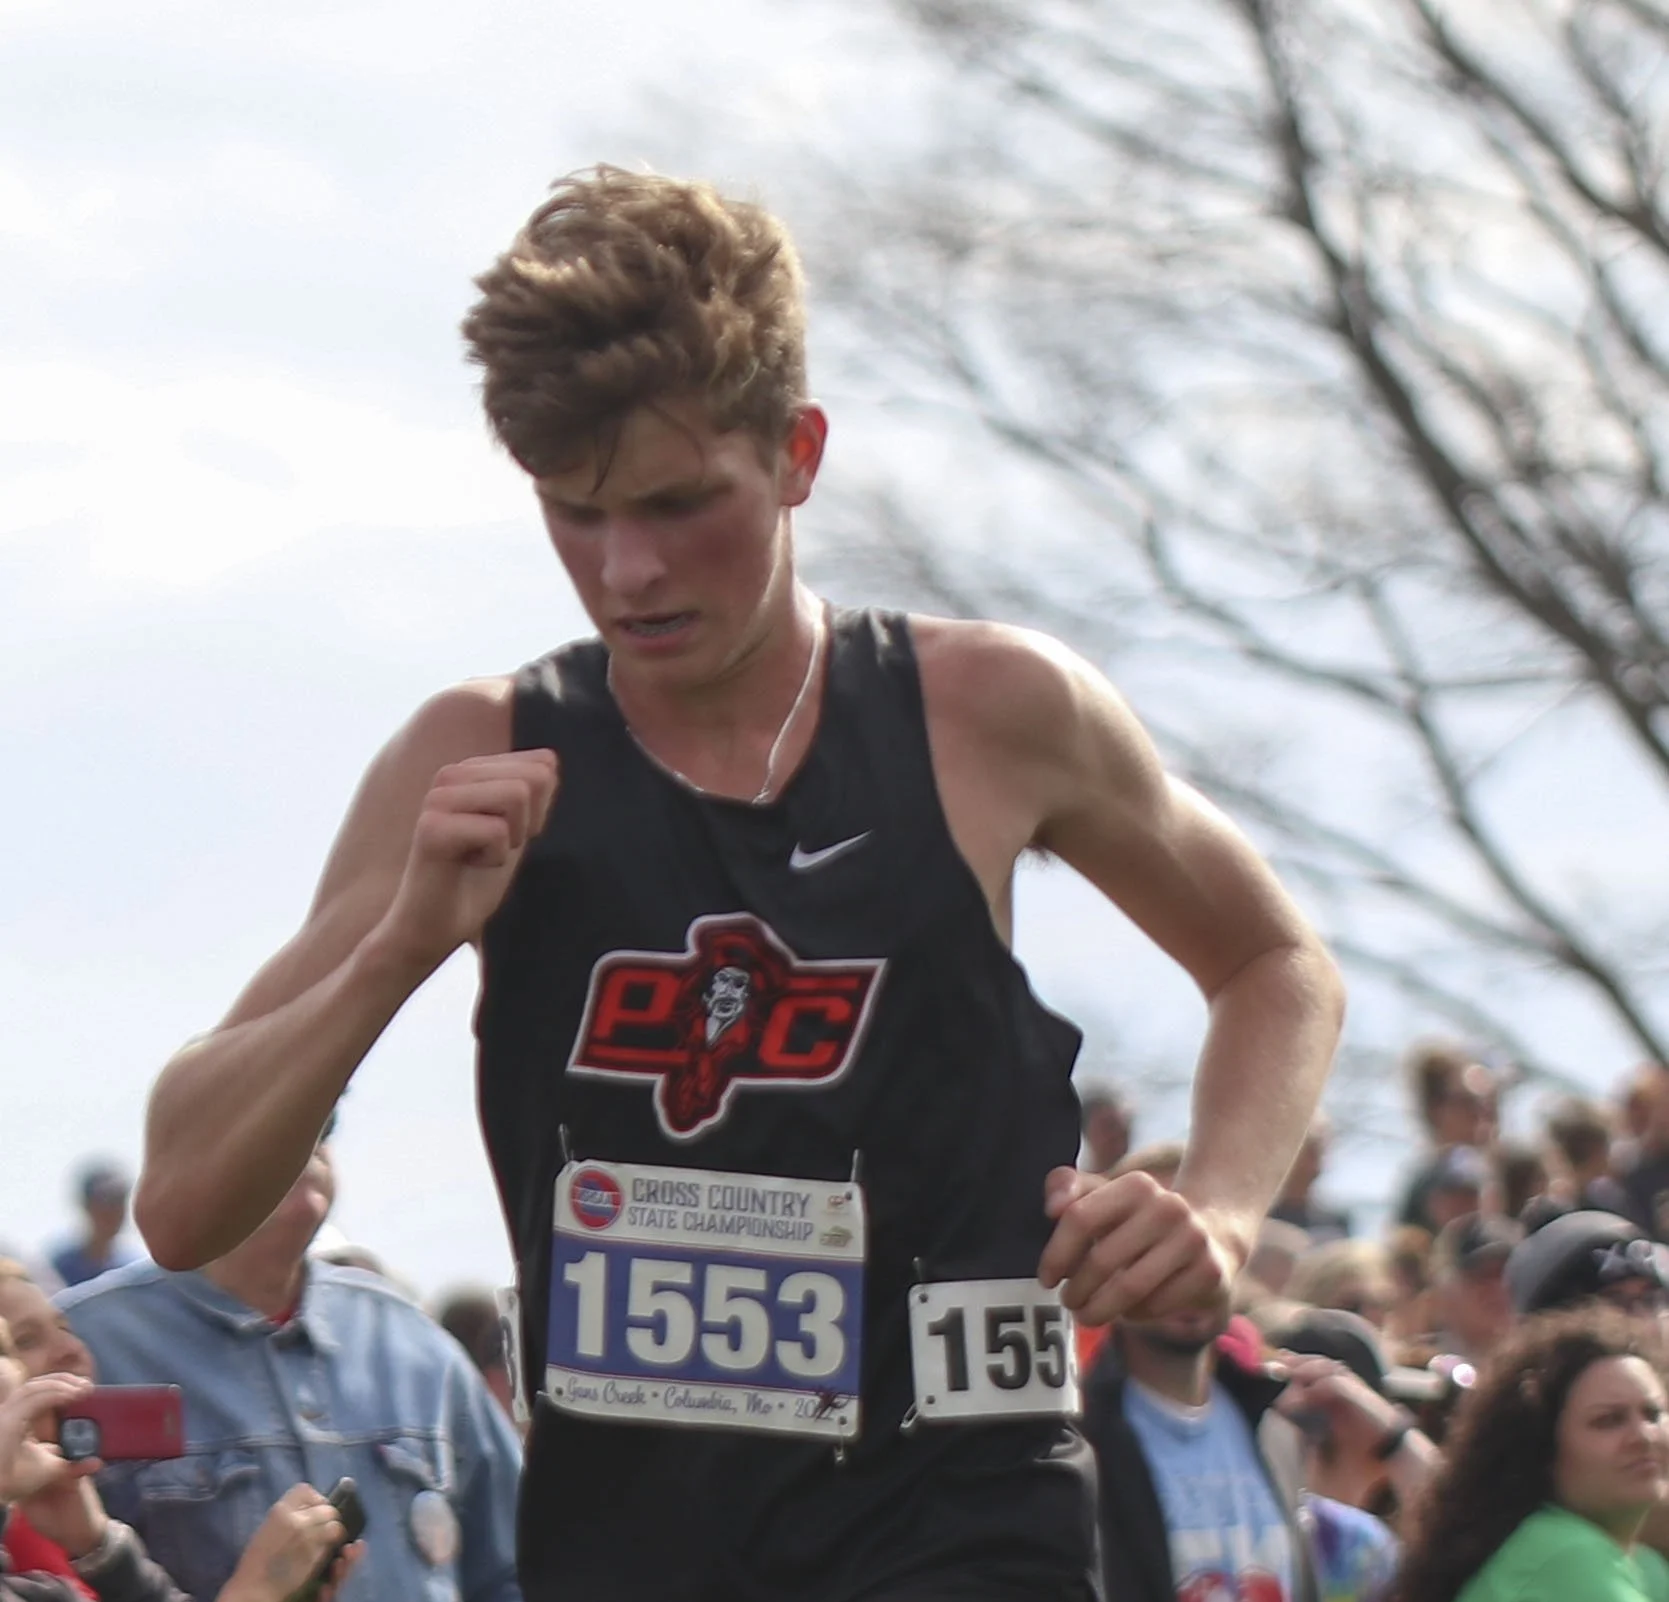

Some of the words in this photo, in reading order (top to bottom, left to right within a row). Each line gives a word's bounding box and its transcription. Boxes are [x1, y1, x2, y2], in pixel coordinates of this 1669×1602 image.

[627, 1206, 678, 1230] STATE
[682, 1211, 815, 1242] CHAMPIONSHIP
[632, 1177, 700, 1208] CROSS
[707, 1184, 812, 1218] COUNTRY
[564, 1250, 845, 1378] 1553
[927, 1306, 1078, 1392] 155
